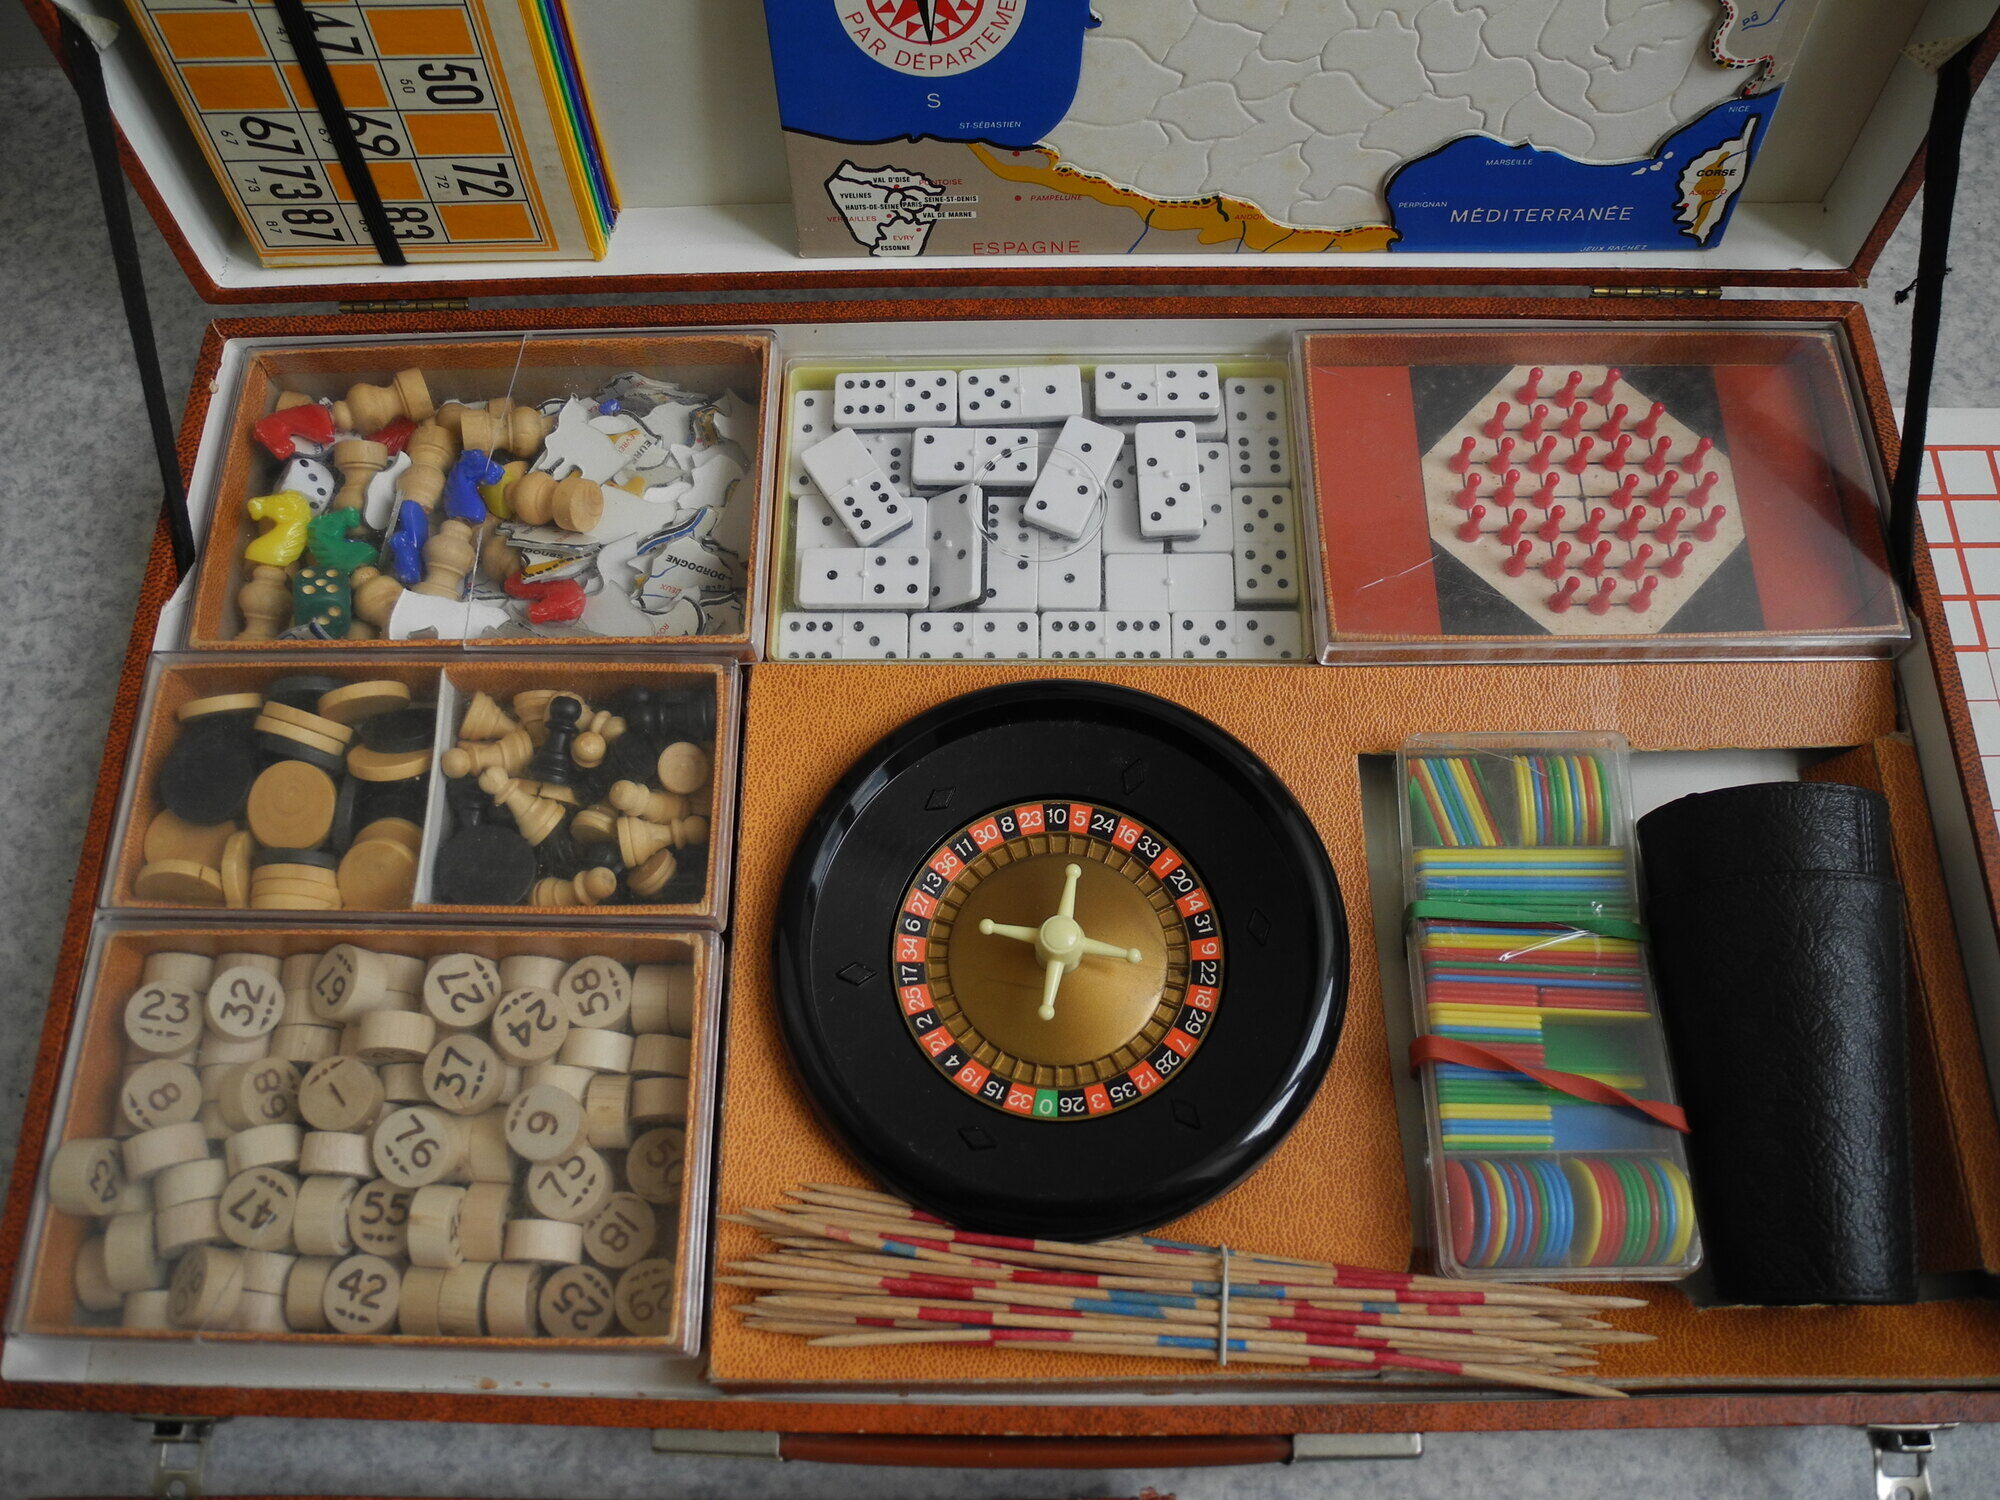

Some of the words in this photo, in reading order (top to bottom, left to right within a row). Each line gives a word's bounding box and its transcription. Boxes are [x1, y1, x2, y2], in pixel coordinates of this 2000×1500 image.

[845, 11, 887, 56] PAR
[400, 79, 416, 94] 50
[418, 63, 484, 104] 50
[926, 93, 942, 109] S
[1728, 105, 1751, 113] NICE
[348, 111, 400, 157] 69
[959, 120, 1022, 130] ST-SÉBASTIEN
[221, 130, 239, 146] 67
[239, 116, 305, 155] 67
[1485, 158, 1533, 166] MARSEILLE
[258, 165, 323, 199] 73
[434, 175, 450, 189] 72
[452, 163, 514, 198] 72
[918, 178, 964, 186] PNTOISE
[1696, 168, 1737, 177] CORSE
[244, 178, 261, 193] 73
[1030, 193, 1083, 201] PAMPELUNE
[382, 207, 435, 239] 83
[1450, 205, 1634, 223] MÉDITERRANÉE
[266, 220, 283, 234] 87
[281, 208, 345, 242] 87
[972, 240, 1081, 256] ESPAGNE
[665, 554, 726, 581] DORDOGNE
[1001, 817, 1015, 832] 8
[1019, 811, 1042, 827] 23
[1047, 808, 1066, 824] 10
[1073, 811, 1086, 826] 5
[1091, 814, 1114, 832] 24
[974, 824, 998, 843] 30
[1120, 826, 1138, 843] 16
[955, 839, 972, 856] 11
[1138, 836, 1161, 858] 33
[935, 853, 957, 876] 36
[1163, 858, 1172, 869] 1
[922, 874, 942, 892] 13
[1170, 869, 1193, 892] 20
[912, 893, 930, 914] 27
[1185, 890, 1203, 911] 14
[906, 919, 921, 931] 6
[1195, 914, 1212, 935] 31
[902, 938, 918, 960] 34
[1202, 942, 1216, 954] 9
[902, 964, 918, 984] 17
[1201, 961, 1216, 985] 22
[316, 966, 346, 1006] 67
[437, 971, 485, 1013] 27
[570, 968, 610, 1017] 58
[139, 989, 190, 1024] 23
[220, 978, 265, 1027] 32
[905, 988, 922, 1010] 25
[1195, 988, 1212, 1008] 18
[506, 998, 557, 1048] 24
[917, 1014, 932, 1028] 2
[1186, 1012, 1206, 1034] 29
[929, 1035, 947, 1051] 21
[1175, 1039, 1191, 1051] 7
[946, 1054, 960, 1067] 4
[1155, 1051, 1179, 1074] 28
[434, 1046, 473, 1097] 37
[962, 1067, 982, 1084] 19
[1135, 1070, 1157, 1089] 12
[149, 1082, 181, 1111] 8
[254, 1068, 288, 1119] 68
[983, 1080, 1004, 1098] 15
[1111, 1081, 1137, 1102] 35
[1008, 1091, 1032, 1110] 32
[1039, 1099, 1052, 1114] 0
[1060, 1097, 1084, 1112] 26
[1091, 1093, 1104, 1108] 3
[395, 1113, 440, 1169] 76
[537, 1155, 586, 1198] 75
[228, 1188, 277, 1229] 47
[360, 1191, 410, 1226] 55
[599, 1211, 640, 1252] 18
[338, 1268, 387, 1309] 42
[552, 1281, 604, 1331] 25
